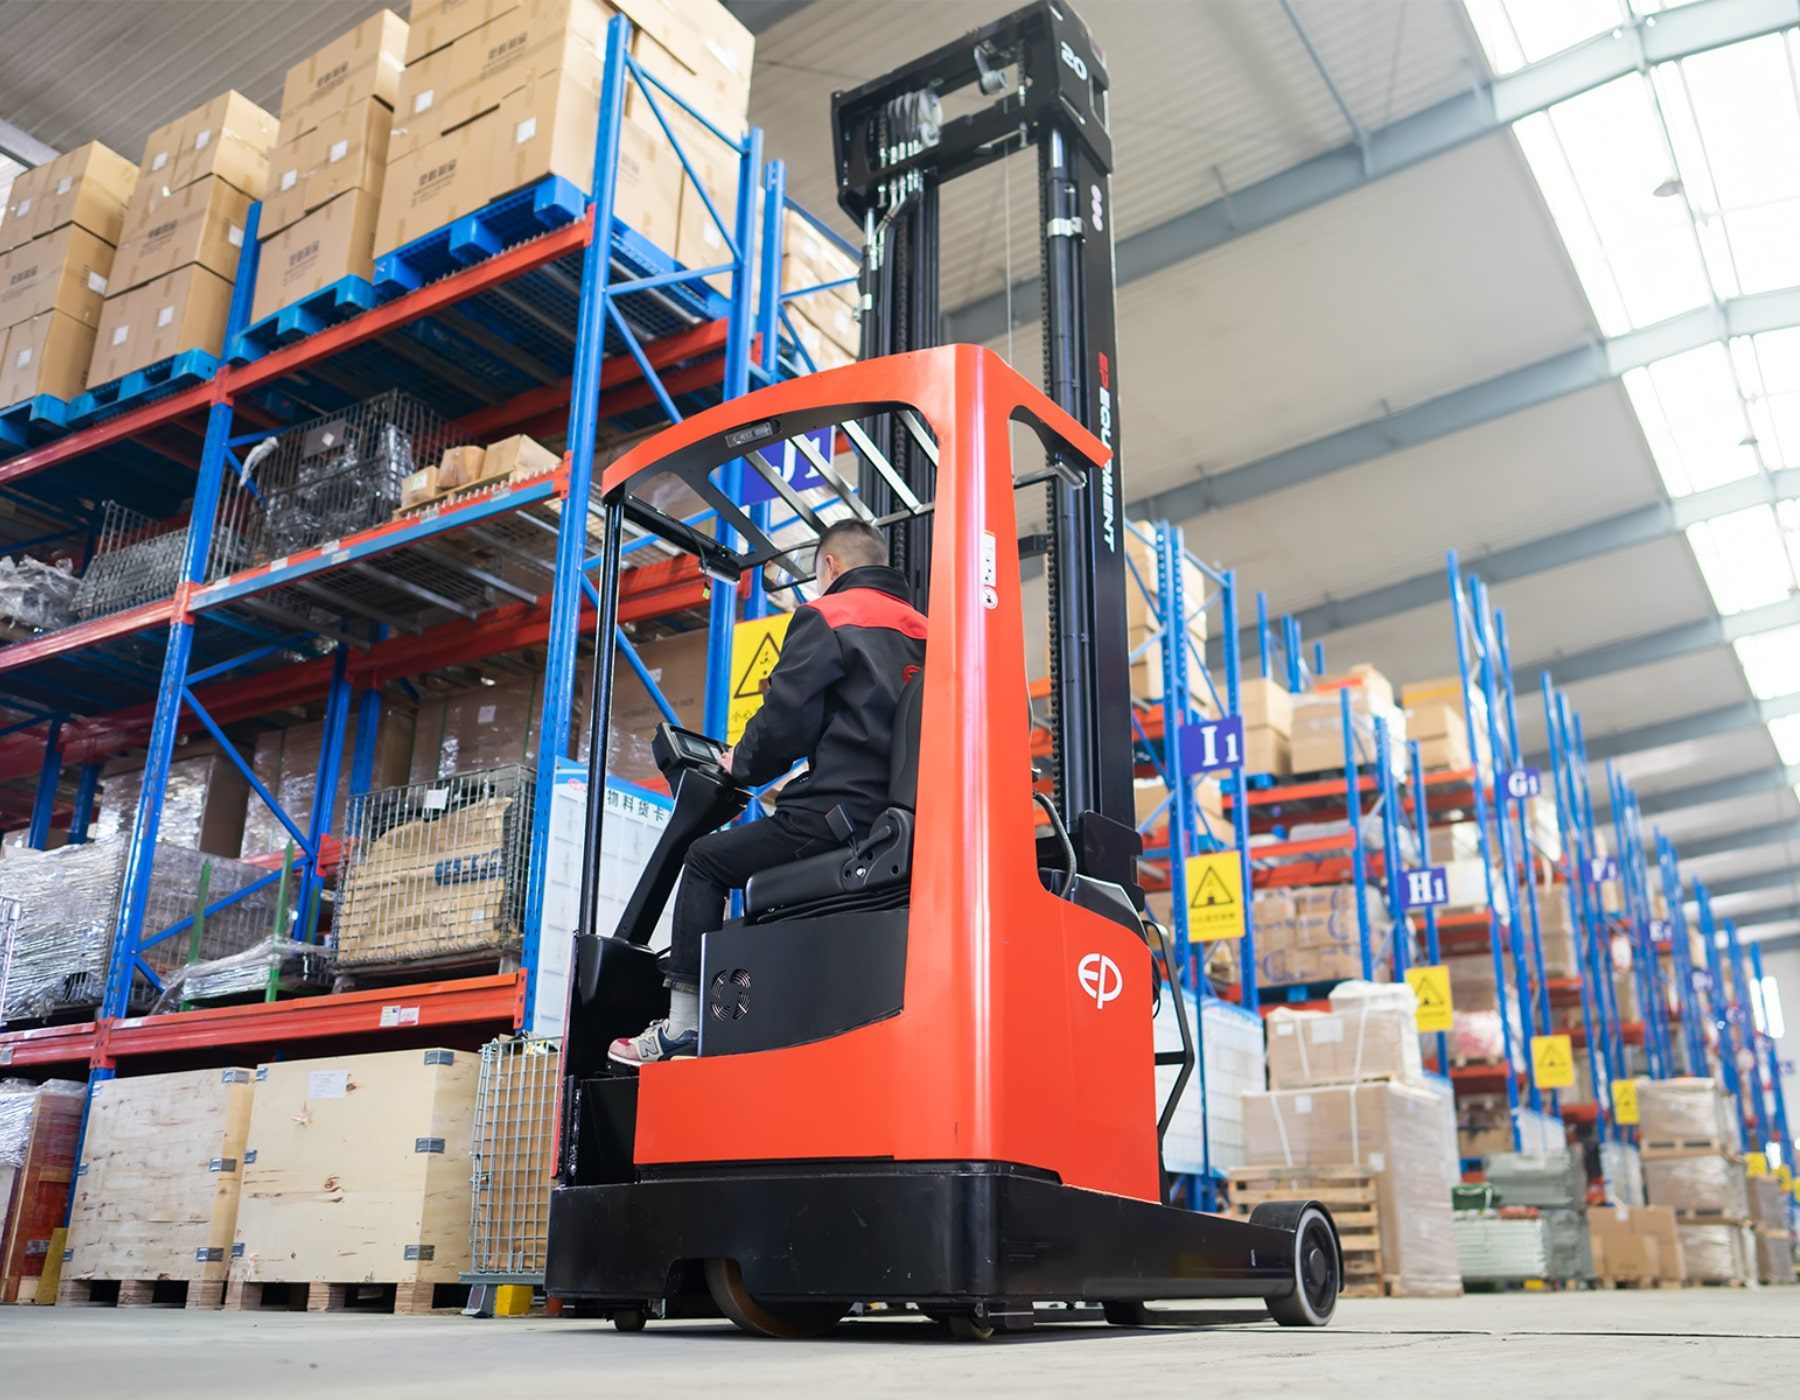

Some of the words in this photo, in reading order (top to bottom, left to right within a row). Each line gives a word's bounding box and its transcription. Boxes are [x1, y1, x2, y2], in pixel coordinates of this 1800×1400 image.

[1060, 41, 1088, 80] 20
[1099, 386, 1115, 553] EQUPMENT
[1200, 725, 1240, 767] I1
[1508, 771, 1537, 797] G1
[1408, 871, 1446, 904] H1
[1078, 952, 1123, 1010] EP
[638, 1035, 660, 1058] N
